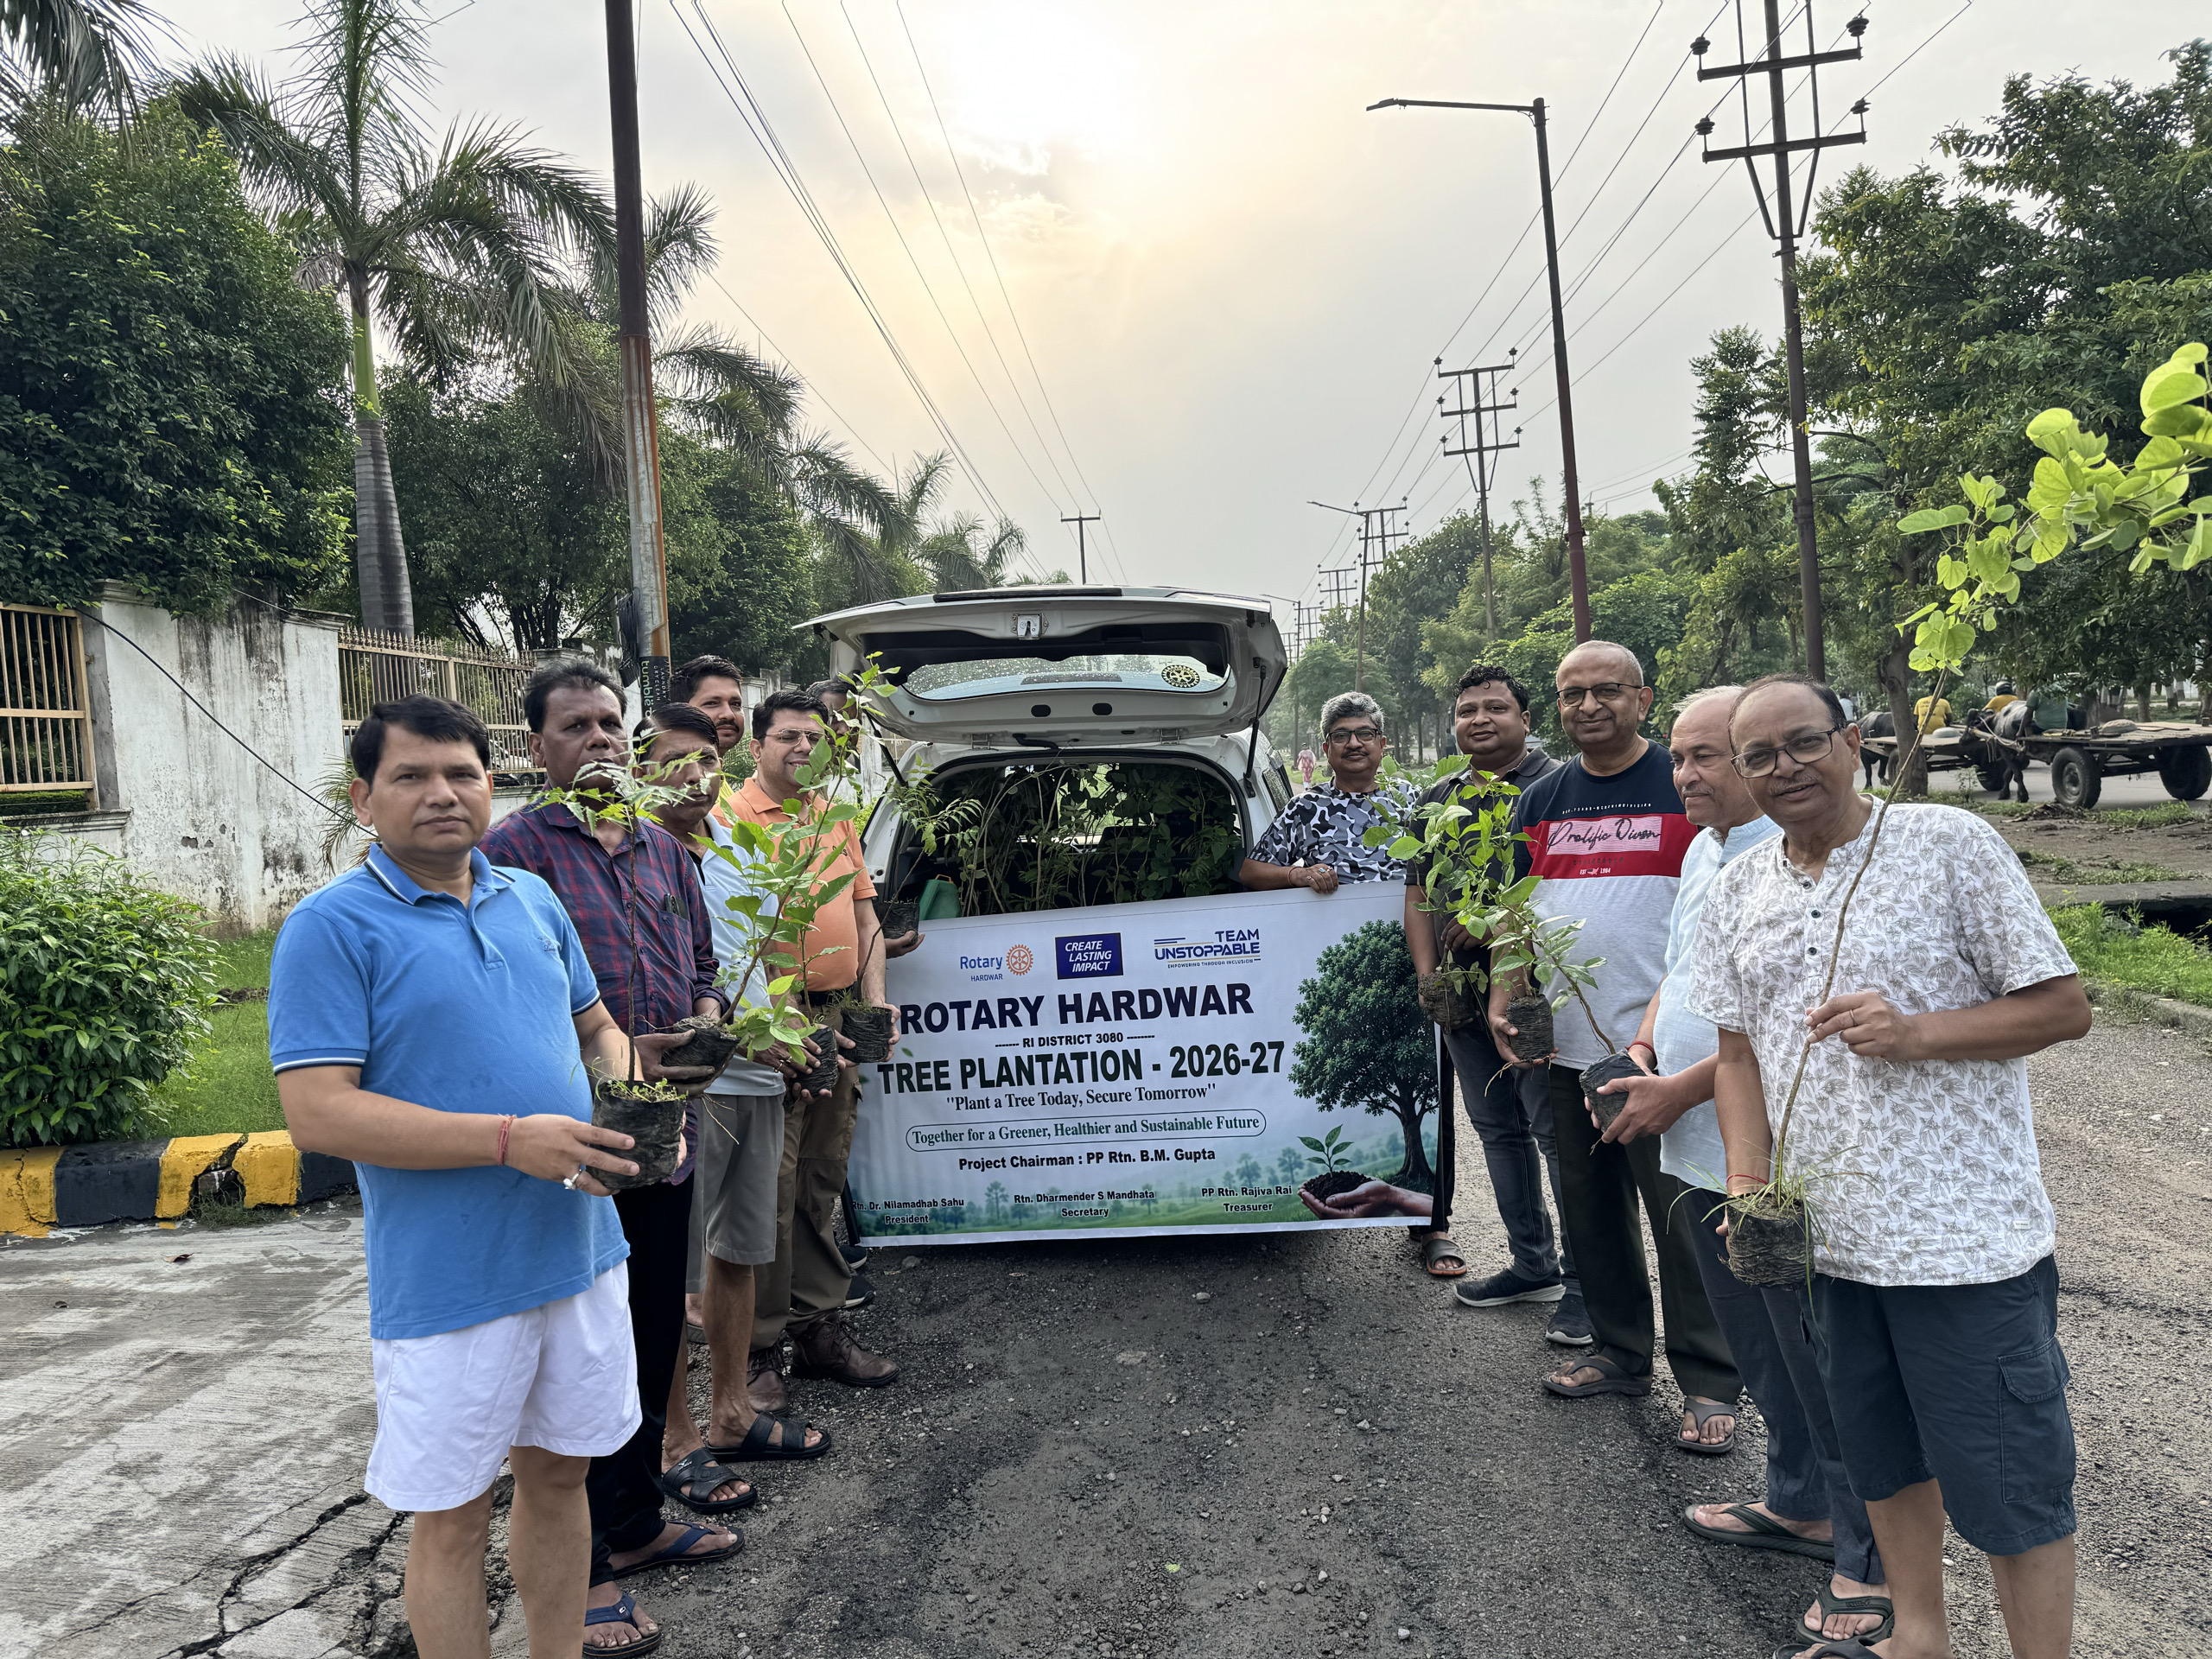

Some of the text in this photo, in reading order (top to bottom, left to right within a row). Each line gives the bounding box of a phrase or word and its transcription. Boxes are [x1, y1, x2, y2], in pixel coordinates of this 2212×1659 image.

[1548, 822, 1611, 851] Prolific
[1215, 929, 1260, 943] TEAM
[1065, 940, 1103, 952] CREATE
[1154, 942, 1260, 961] UNSTOPPABLE
[960, 956, 1002, 969] Rotary
[1069, 950, 1112, 963] LASTING
[1071, 961, 1110, 973] IMPACT
[971, 973, 1003, 982] HARDWAR
[899, 983, 1255, 1035] ROTARY HARDWAR
[1023, 1037, 1034, 1048] RI
[1039, 1033, 1092, 1047] DISTRICT
[1096, 1032, 1123, 1044] 3080
[877, 1040, 1285, 1095] TREE PLANTATION - 2026-27
[946, 1084, 1216, 1111] "Plant a Tree Today, Secure Tomorrow"
[912, 1116, 1260, 1147] Together for a Greener, Healthier and Sustainable Future
[959, 1147, 1215, 1172] Project Chairman : PP Rtn. B.M. Gupta
[1014, 1189, 1154, 1203] Rtn. Dharmender S Mandhata
[1201, 1185, 1293, 1198] PP Rtn. Rajiva Rai
[869, 1201, 881, 1210] Dr.
[883, 1198, 938, 1210] Nilamadhab
[941, 1198, 964, 1207] Sahu
[1224, 1203, 1273, 1211] Treasurer
[885, 1213, 929, 1224] President
[1061, 1208, 1109, 1218] Secretary
